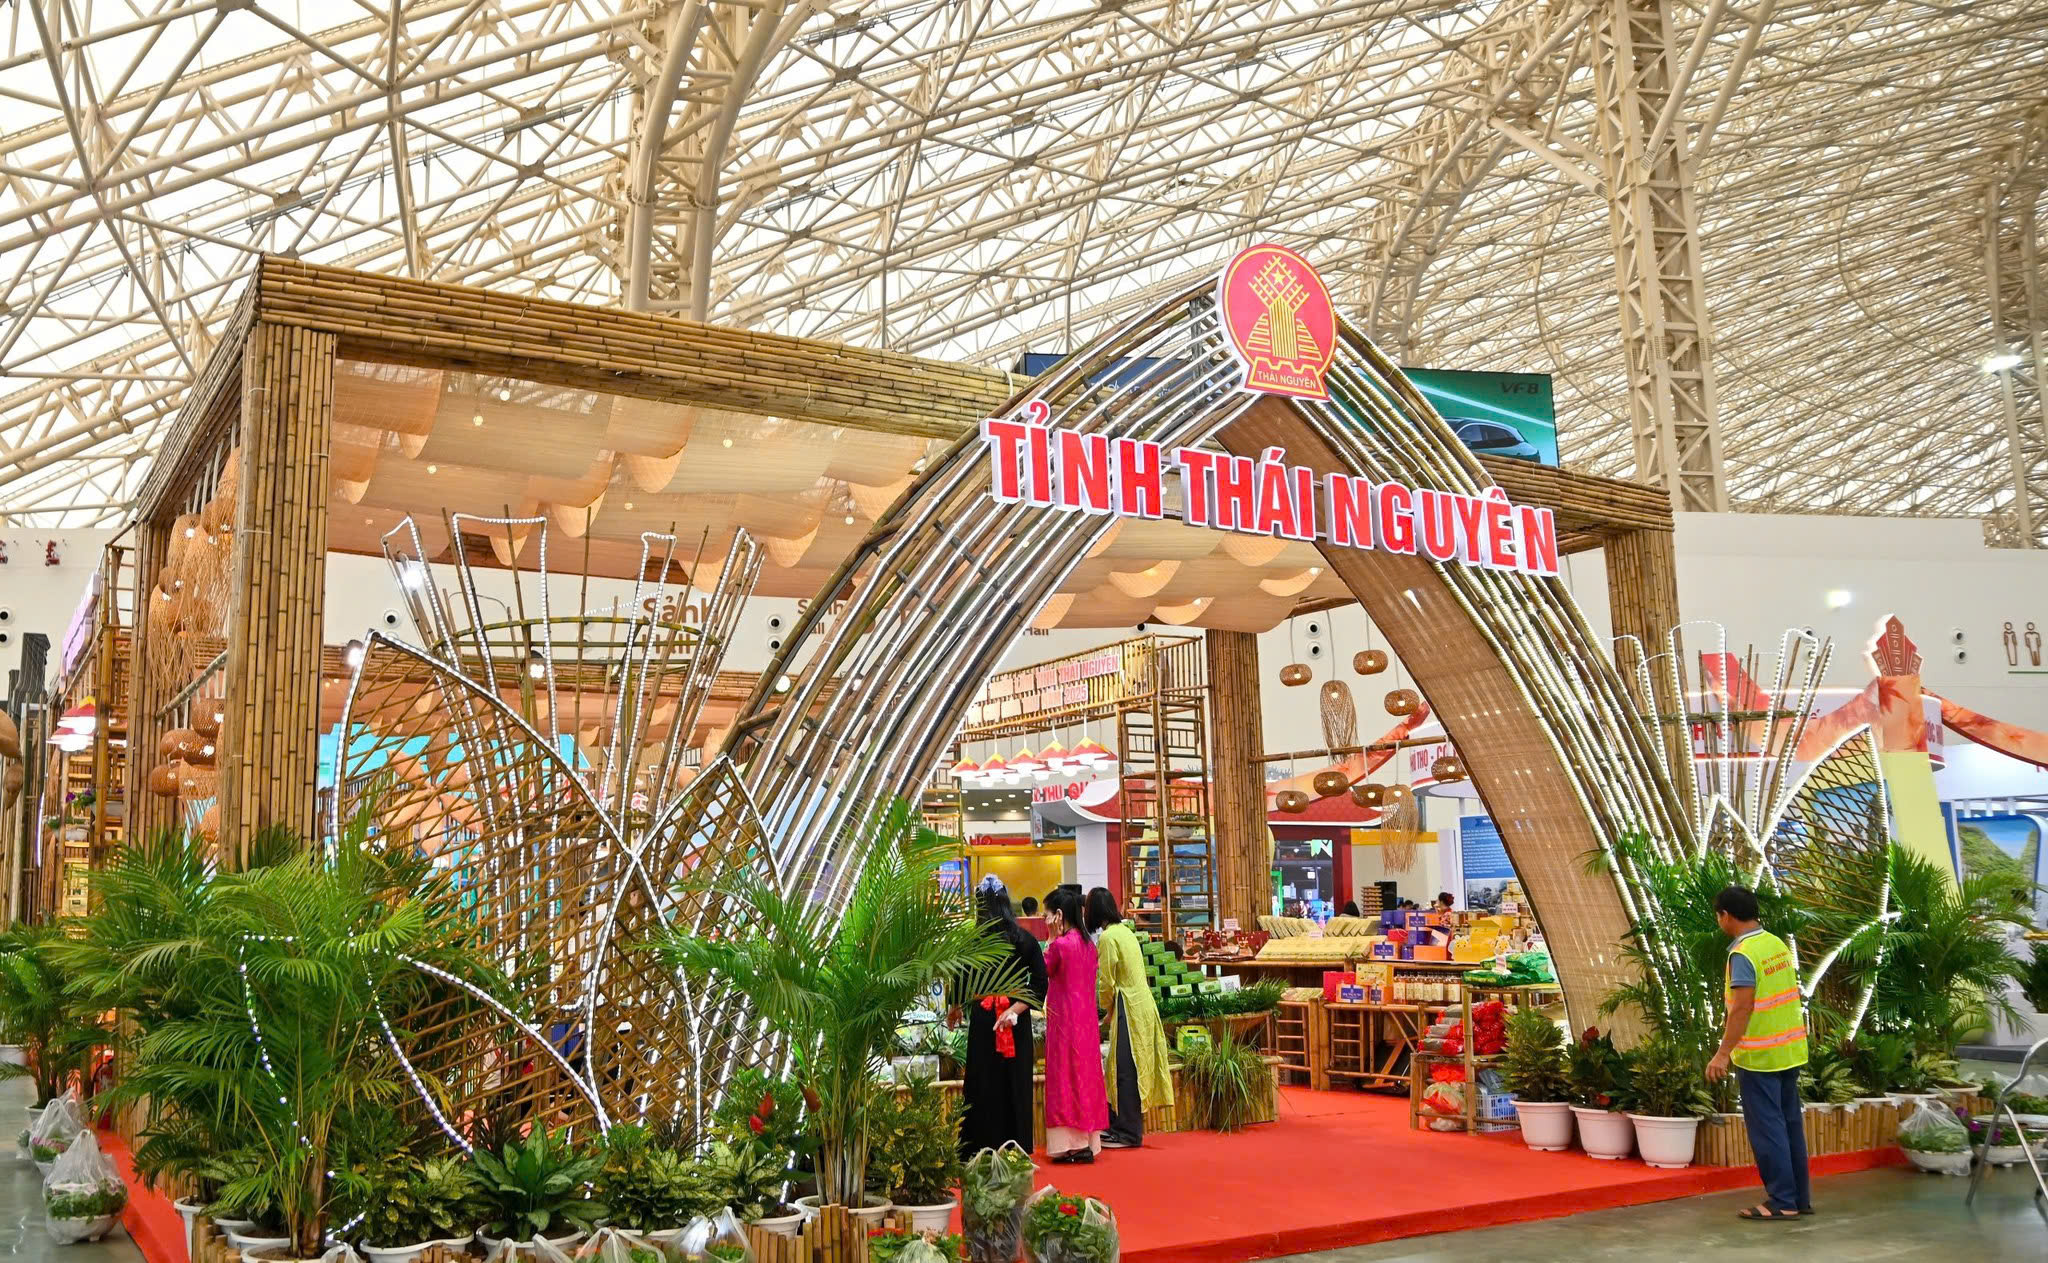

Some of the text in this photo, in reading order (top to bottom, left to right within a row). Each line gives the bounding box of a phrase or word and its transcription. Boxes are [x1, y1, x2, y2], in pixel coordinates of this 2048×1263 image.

[1257, 370, 1317, 389] THÁI NGUYÊN
[983, 400, 1559, 576] TỈNH THÁI NGUYÊN
